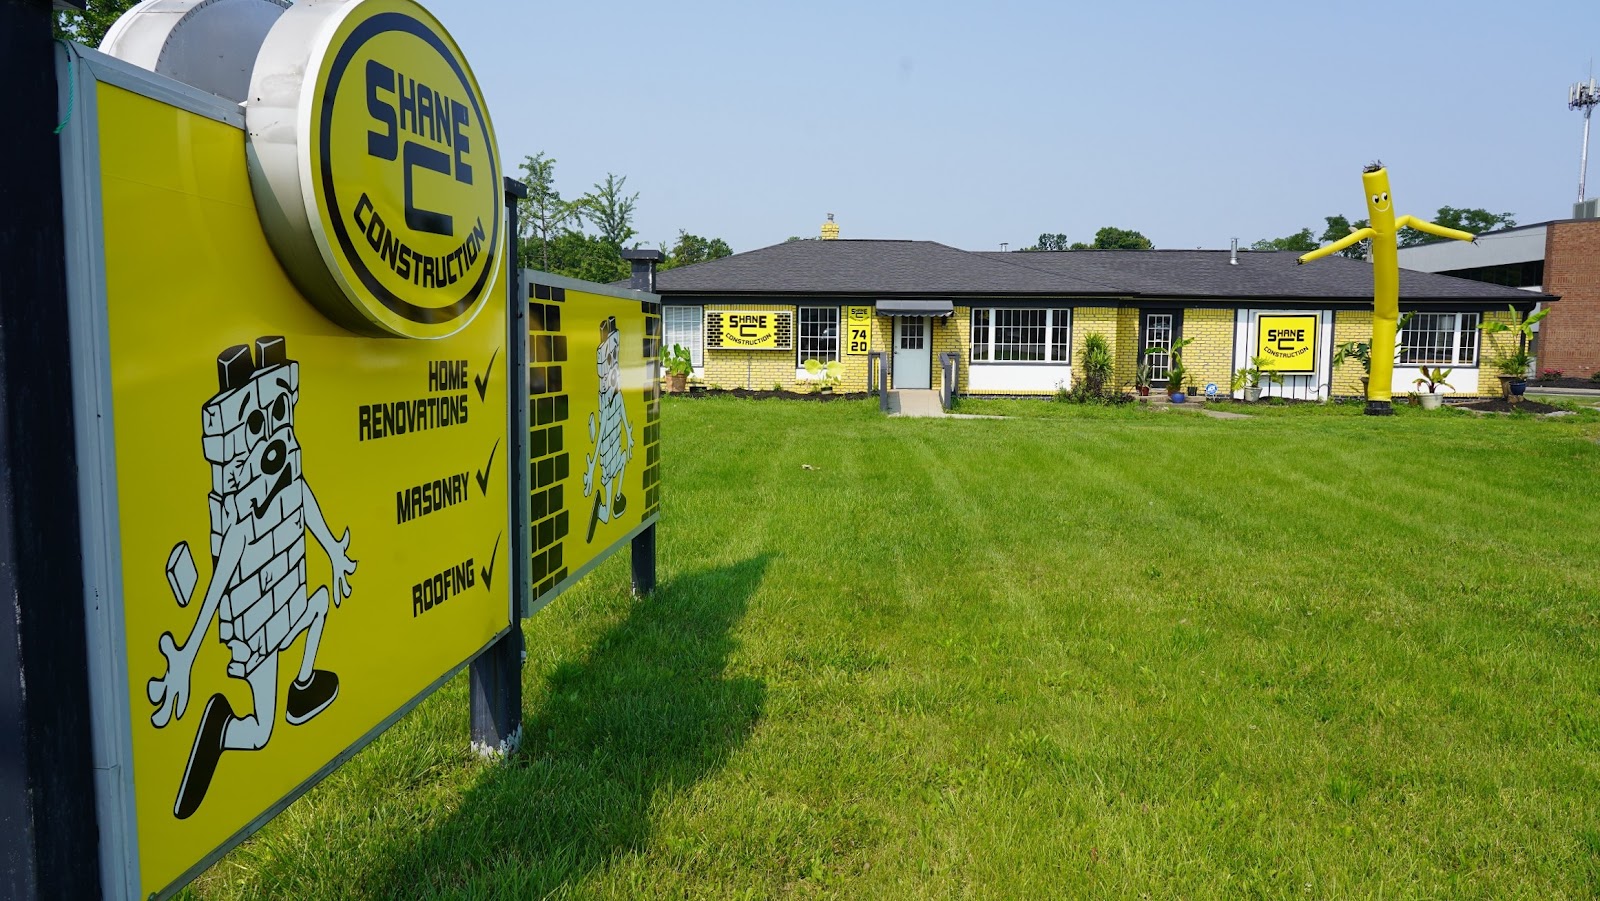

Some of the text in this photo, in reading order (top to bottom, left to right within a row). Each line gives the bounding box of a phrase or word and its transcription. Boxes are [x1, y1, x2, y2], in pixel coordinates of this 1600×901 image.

[366, 59, 473, 185] SHANE
[403, 140, 454, 236] C
[353, 192, 486, 289] CONSTRUCTION
[729, 315, 767, 328] SHANE
[740, 325, 757, 337] C
[852, 330, 866, 340] 74
[1268, 329, 1305, 342] SHANE
[725, 332, 772, 346] CONSTRUCTION
[851, 341, 867, 351] 20
[1278, 338, 1294, 350] C
[1263, 346, 1309, 358] CONSTRUCTION
[429, 360, 468, 392] HOME
[359, 394, 468, 441] RENOVATIONS
[397, 471, 469, 525] MASONRY
[412, 557, 475, 618] ROOFING
